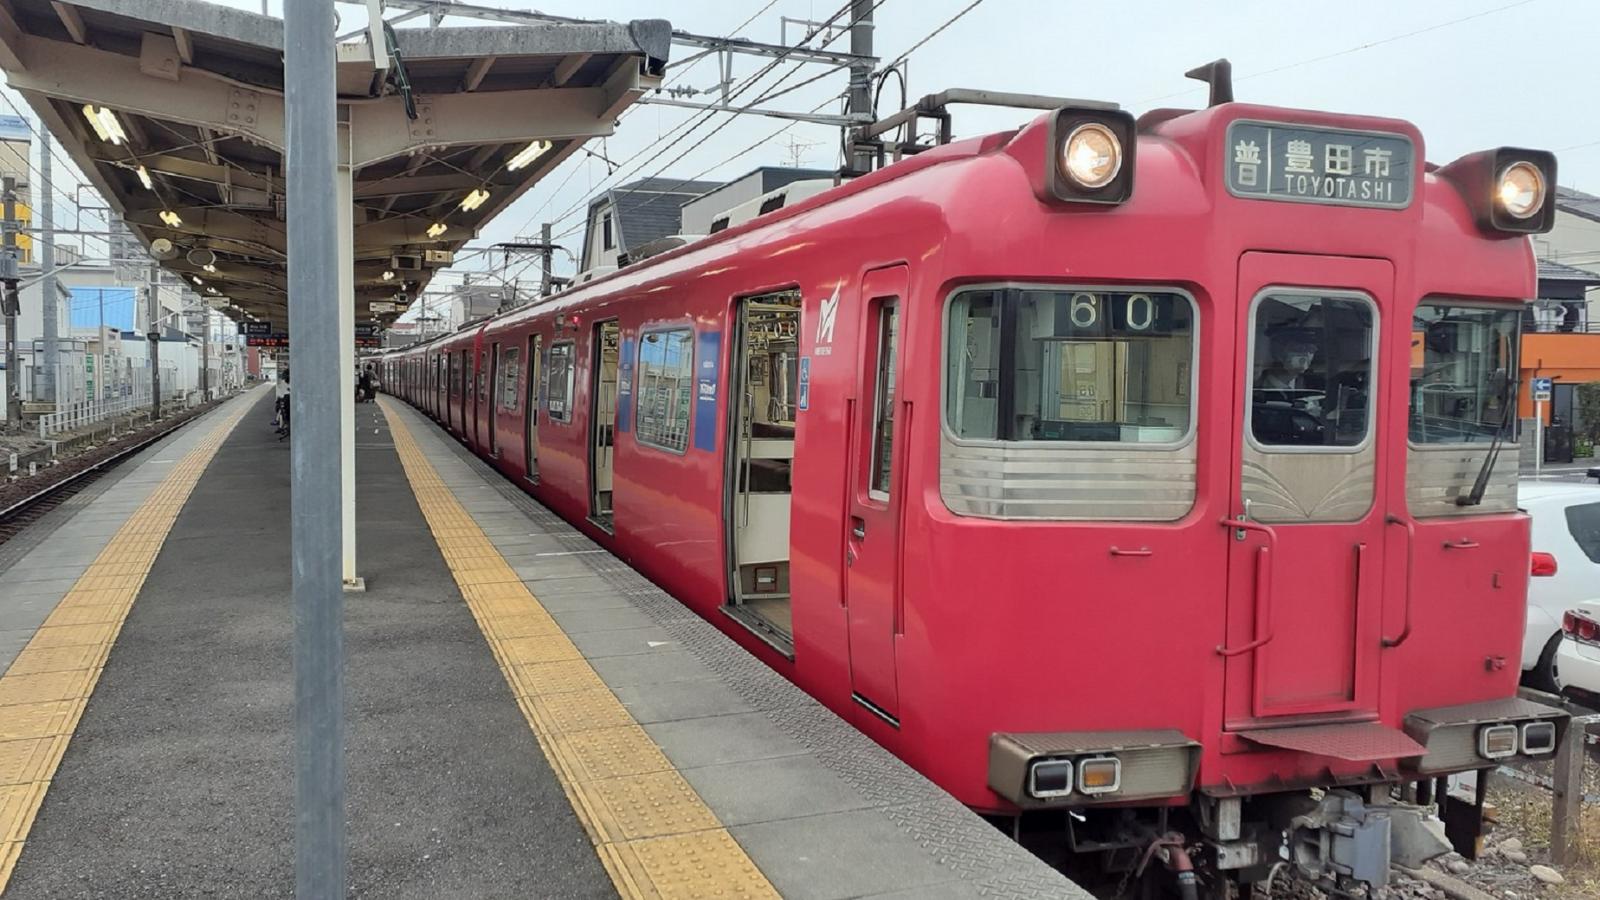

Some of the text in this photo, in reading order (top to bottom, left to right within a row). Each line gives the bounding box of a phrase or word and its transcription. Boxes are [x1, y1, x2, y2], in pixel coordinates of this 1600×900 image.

[1235, 140, 1261, 186] 普
[1284, 140, 1392, 178] 豊田市
[1284, 174, 1392, 201] TOYOTASHI
[372, 326, 380, 336] 2
